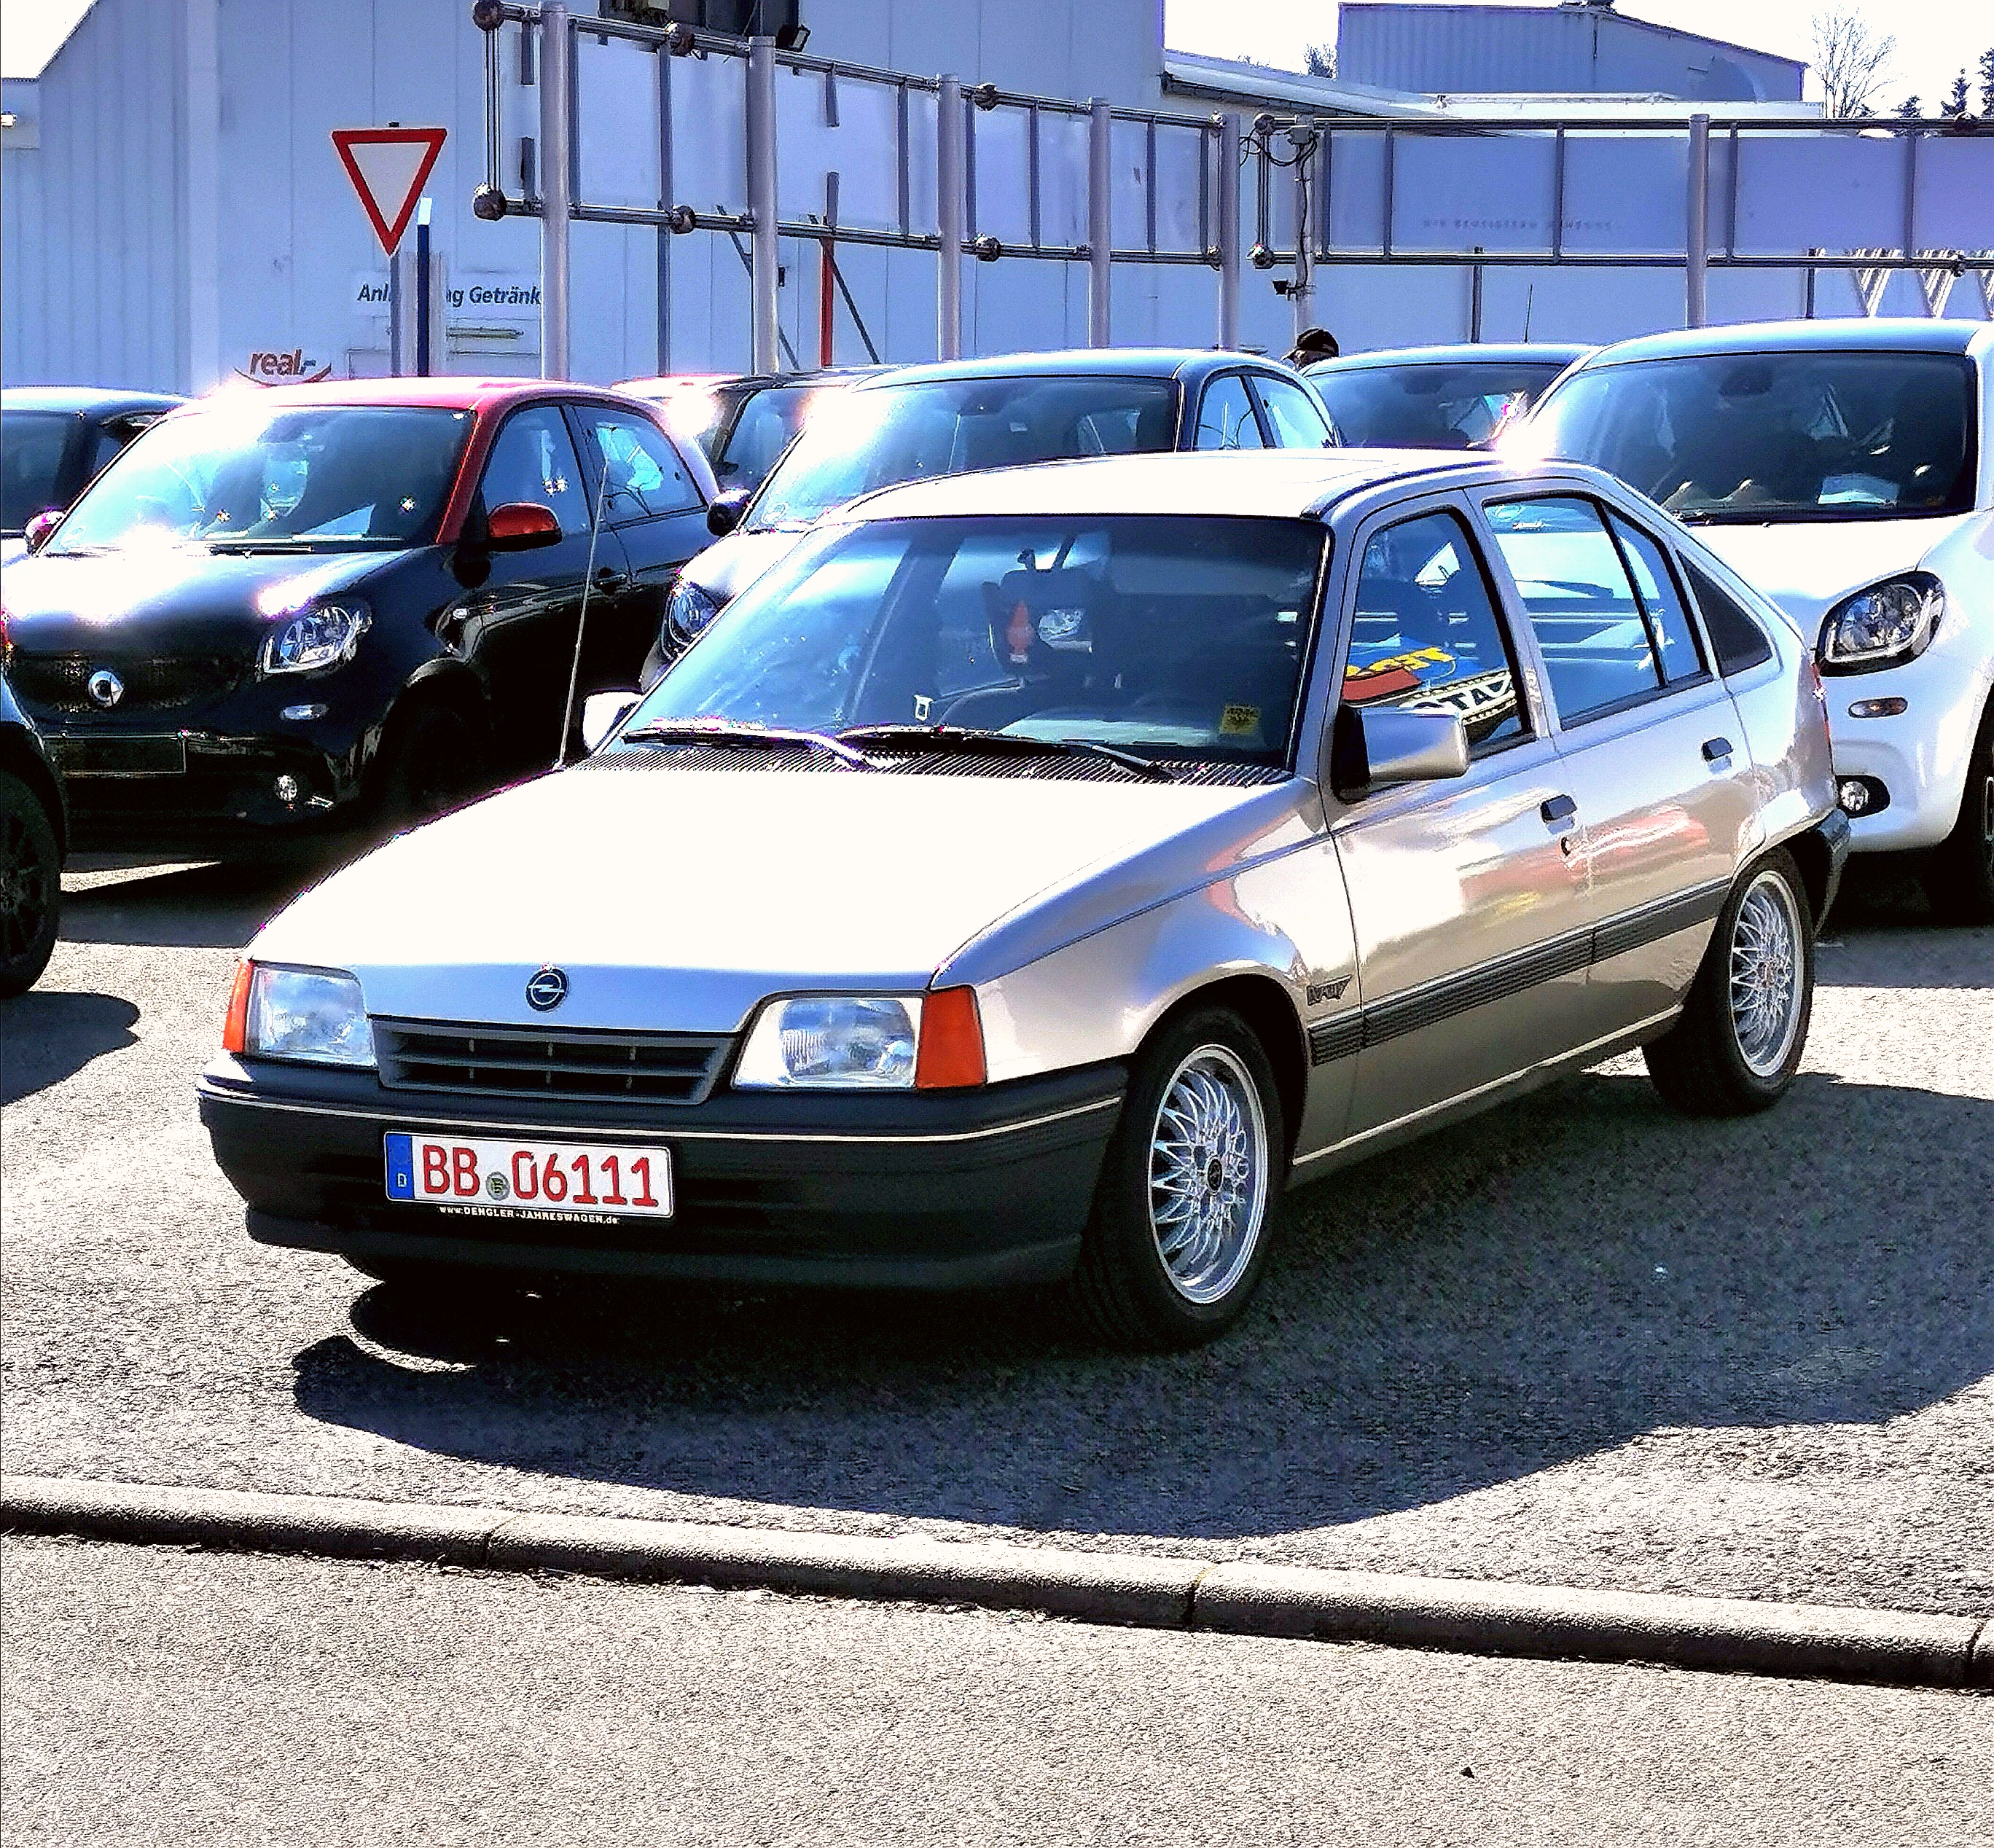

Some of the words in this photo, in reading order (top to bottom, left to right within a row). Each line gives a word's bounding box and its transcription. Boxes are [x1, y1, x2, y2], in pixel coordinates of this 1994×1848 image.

[469, 285, 541, 305] Getränk
[397, 1172, 407, 1188] D
[422, 1144, 481, 1197] BB
[512, 1151, 659, 1208] 06111
